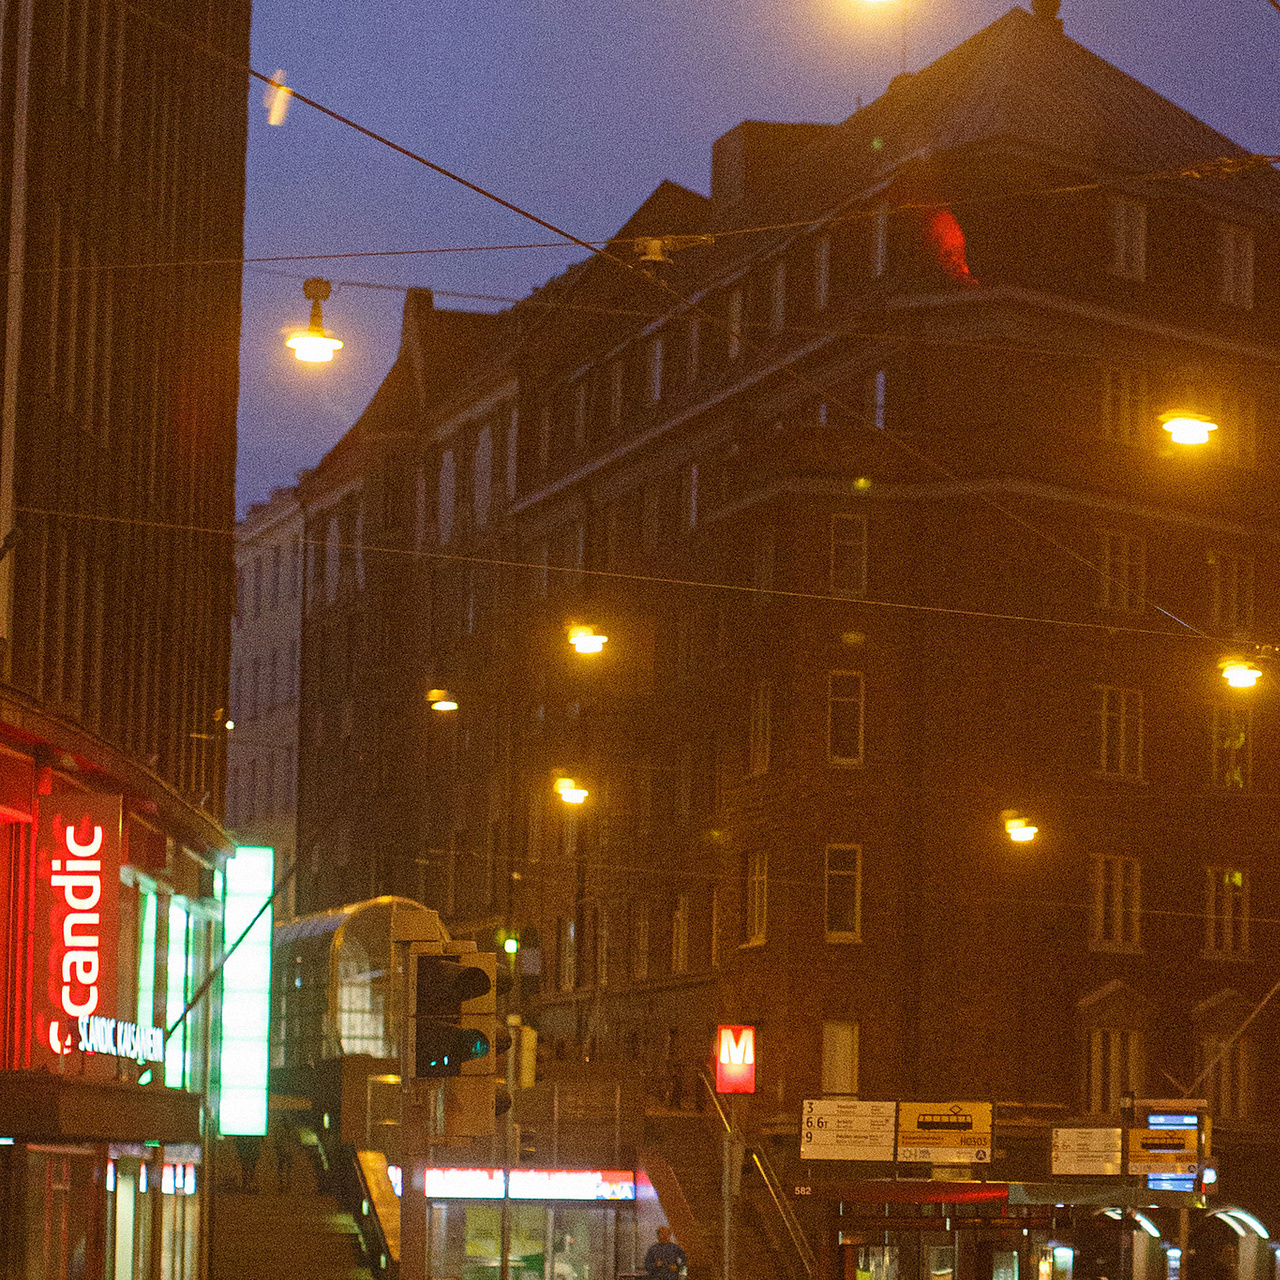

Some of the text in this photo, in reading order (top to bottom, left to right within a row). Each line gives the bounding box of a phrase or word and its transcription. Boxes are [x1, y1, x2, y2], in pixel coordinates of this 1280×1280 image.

[78, 1014, 117, 1055] SCANDIC
[720, 1028, 754, 1065] M
[807, 1102, 814, 1113] 3
[805, 1132, 813, 1143] 9
[795, 1187, 811, 1195] 582
